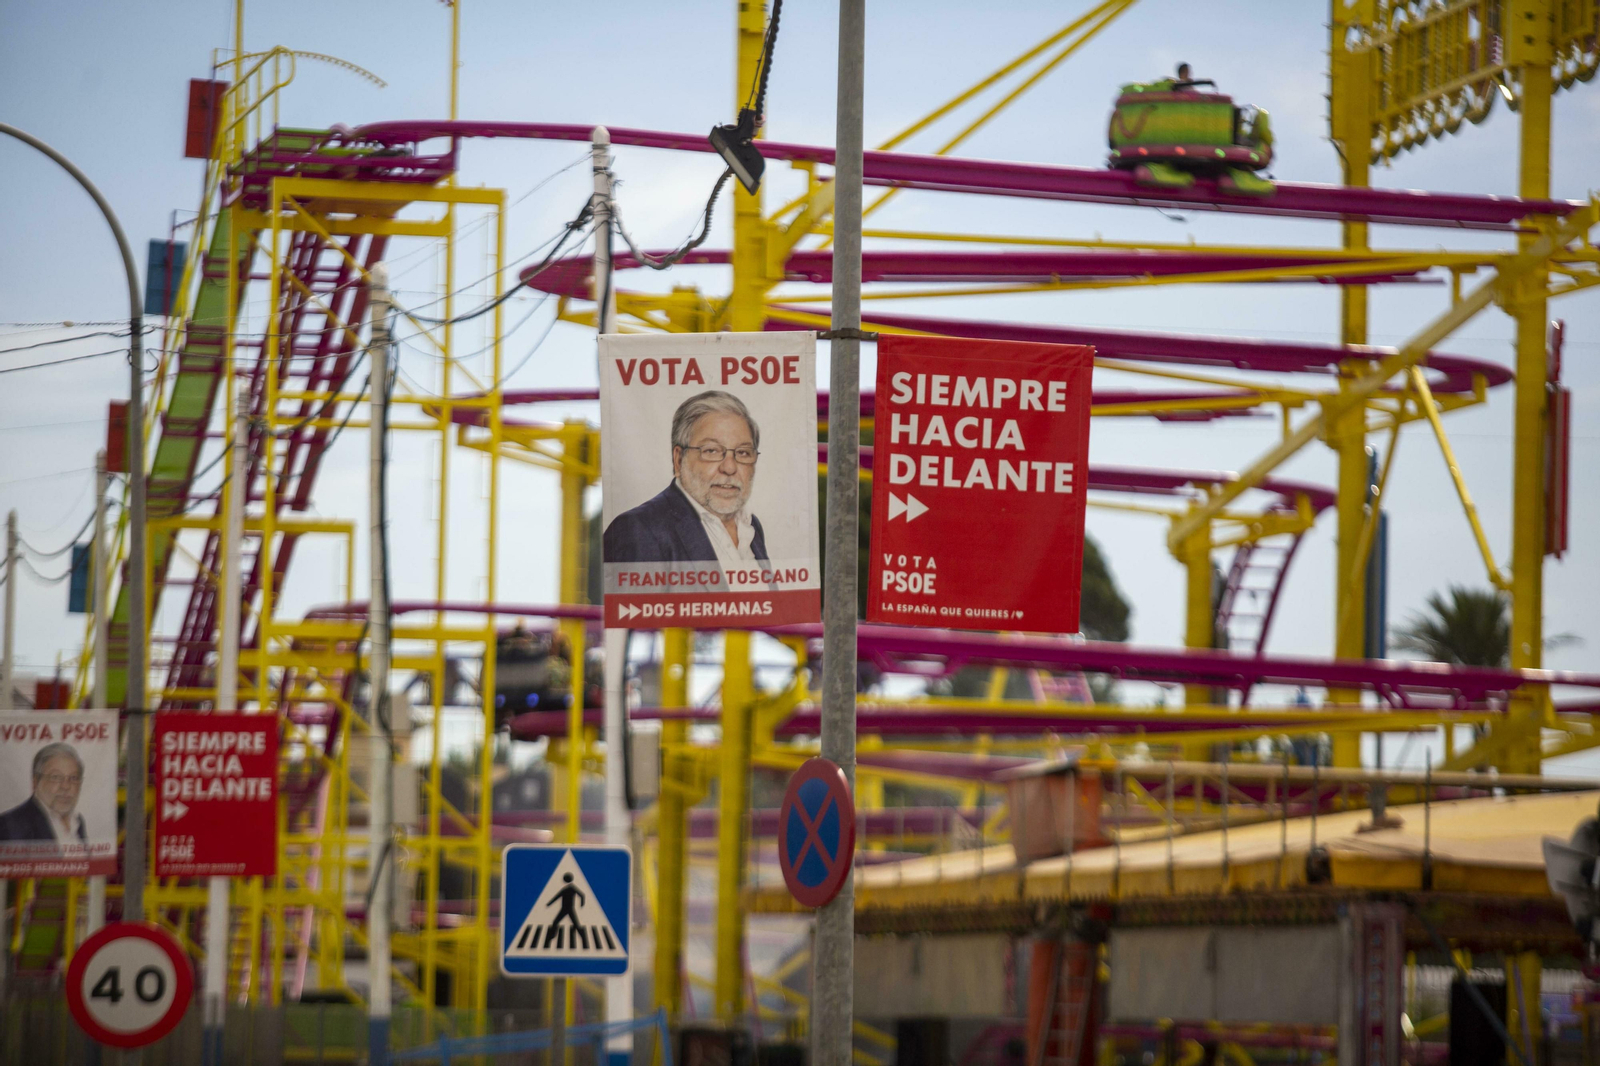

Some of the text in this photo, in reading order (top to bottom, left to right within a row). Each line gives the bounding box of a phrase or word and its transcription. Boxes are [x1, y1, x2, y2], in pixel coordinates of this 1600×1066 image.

[615, 355, 800, 386] VOTA PSOE
[890, 371, 1067, 412] SIEMPRE
[890, 413, 1025, 451] HACIA
[889, 453, 1073, 493] DELANTE
[883, 553, 937, 569] VOTA
[618, 568, 809, 587] FRANCISCO TOSCANO
[882, 570, 937, 595] PSOE
[642, 601, 773, 618] DOS HERMANAS
[882, 602, 1009, 619] LA ESPAÑA QUE QUIERES
[1, 723, 109, 741] VOTA PSOE
[163, 731, 266, 753] SIEMPRE
[163, 754, 243, 776] HACIA
[162, 777, 272, 799] DELANTE
[91, 965, 167, 1005] 40
